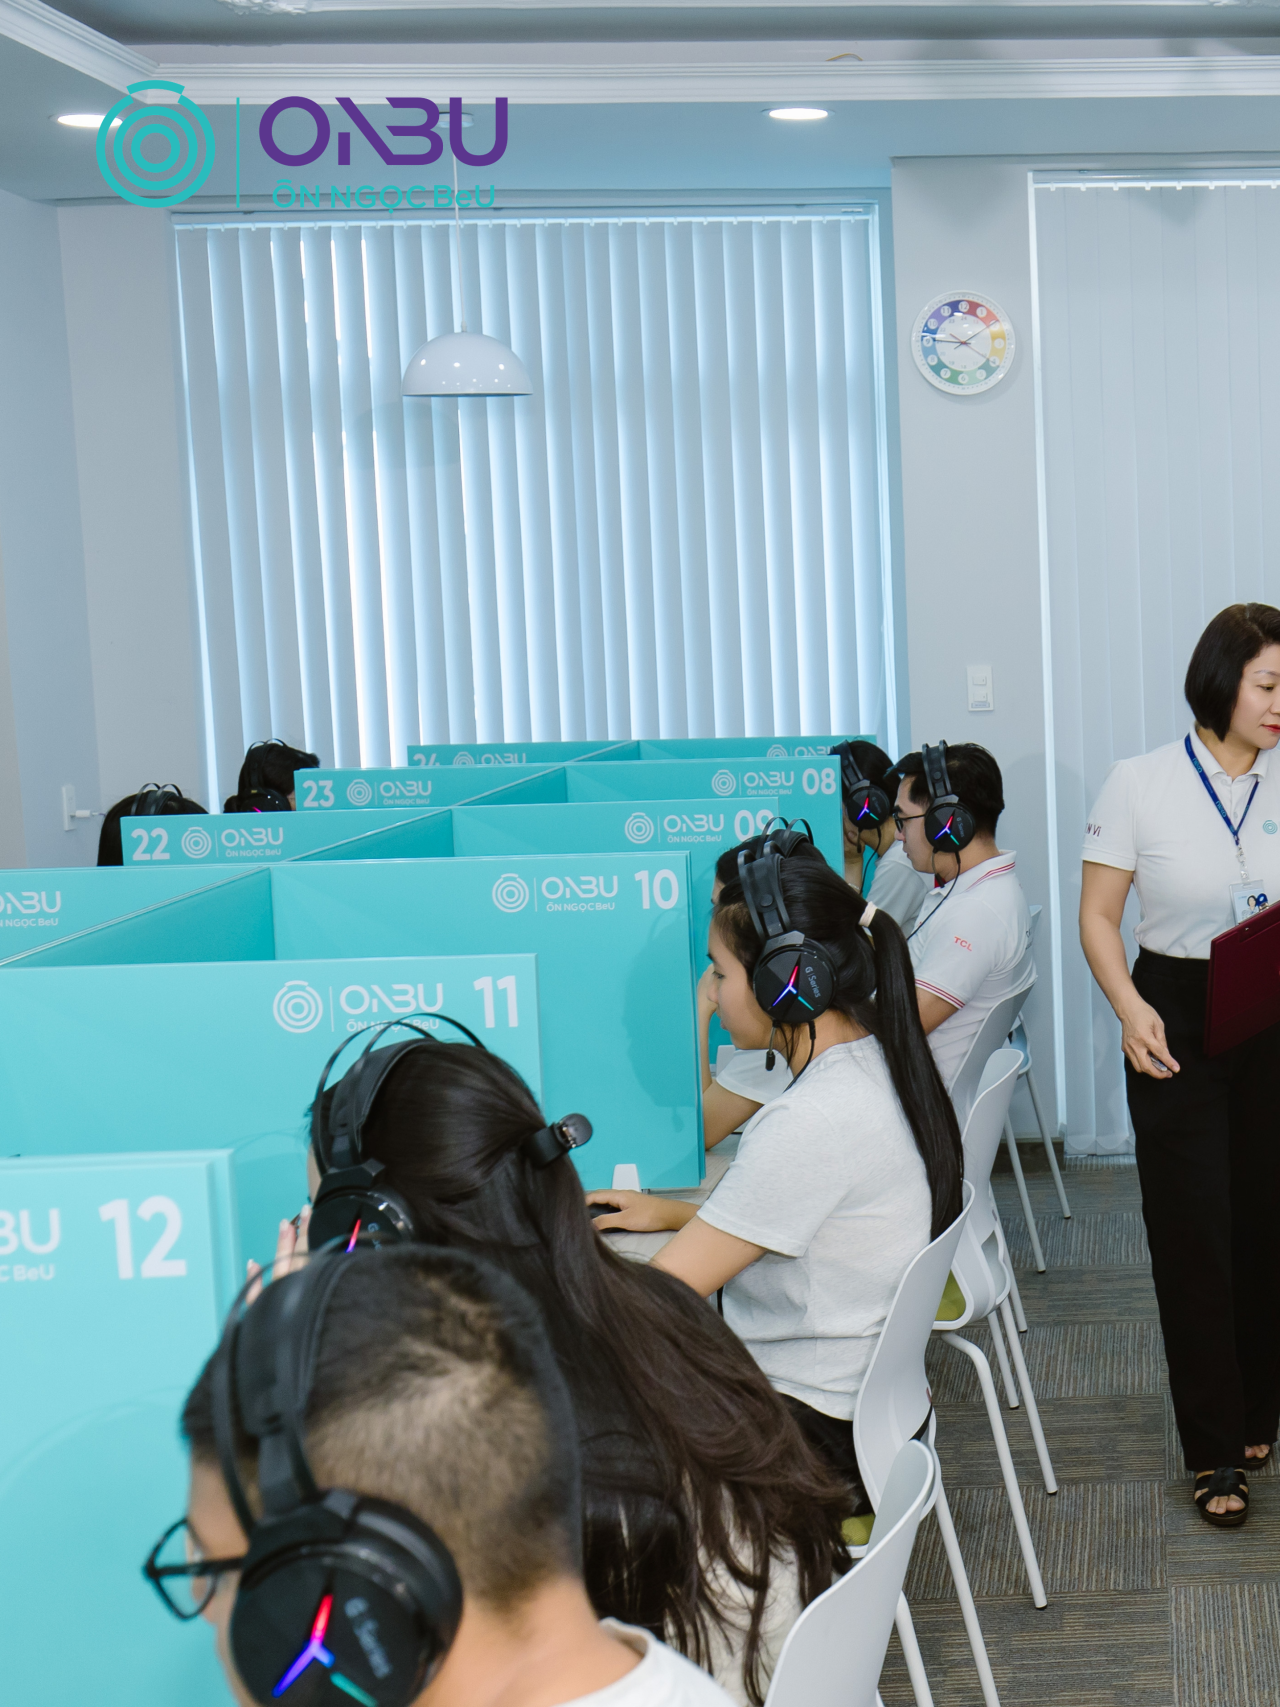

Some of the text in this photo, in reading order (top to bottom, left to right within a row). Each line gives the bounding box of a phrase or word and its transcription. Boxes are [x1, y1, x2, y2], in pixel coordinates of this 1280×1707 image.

[303, 780, 334, 807] 23
[802, 768, 836, 794] 08
[131, 828, 170, 860] 22
[0, 891, 61, 914] NBU
[634, 869, 679, 910] 10
[954, 936, 972, 952] TCL
[473, 976, 518, 1028] 11
[98, 1195, 187, 1280] 12
